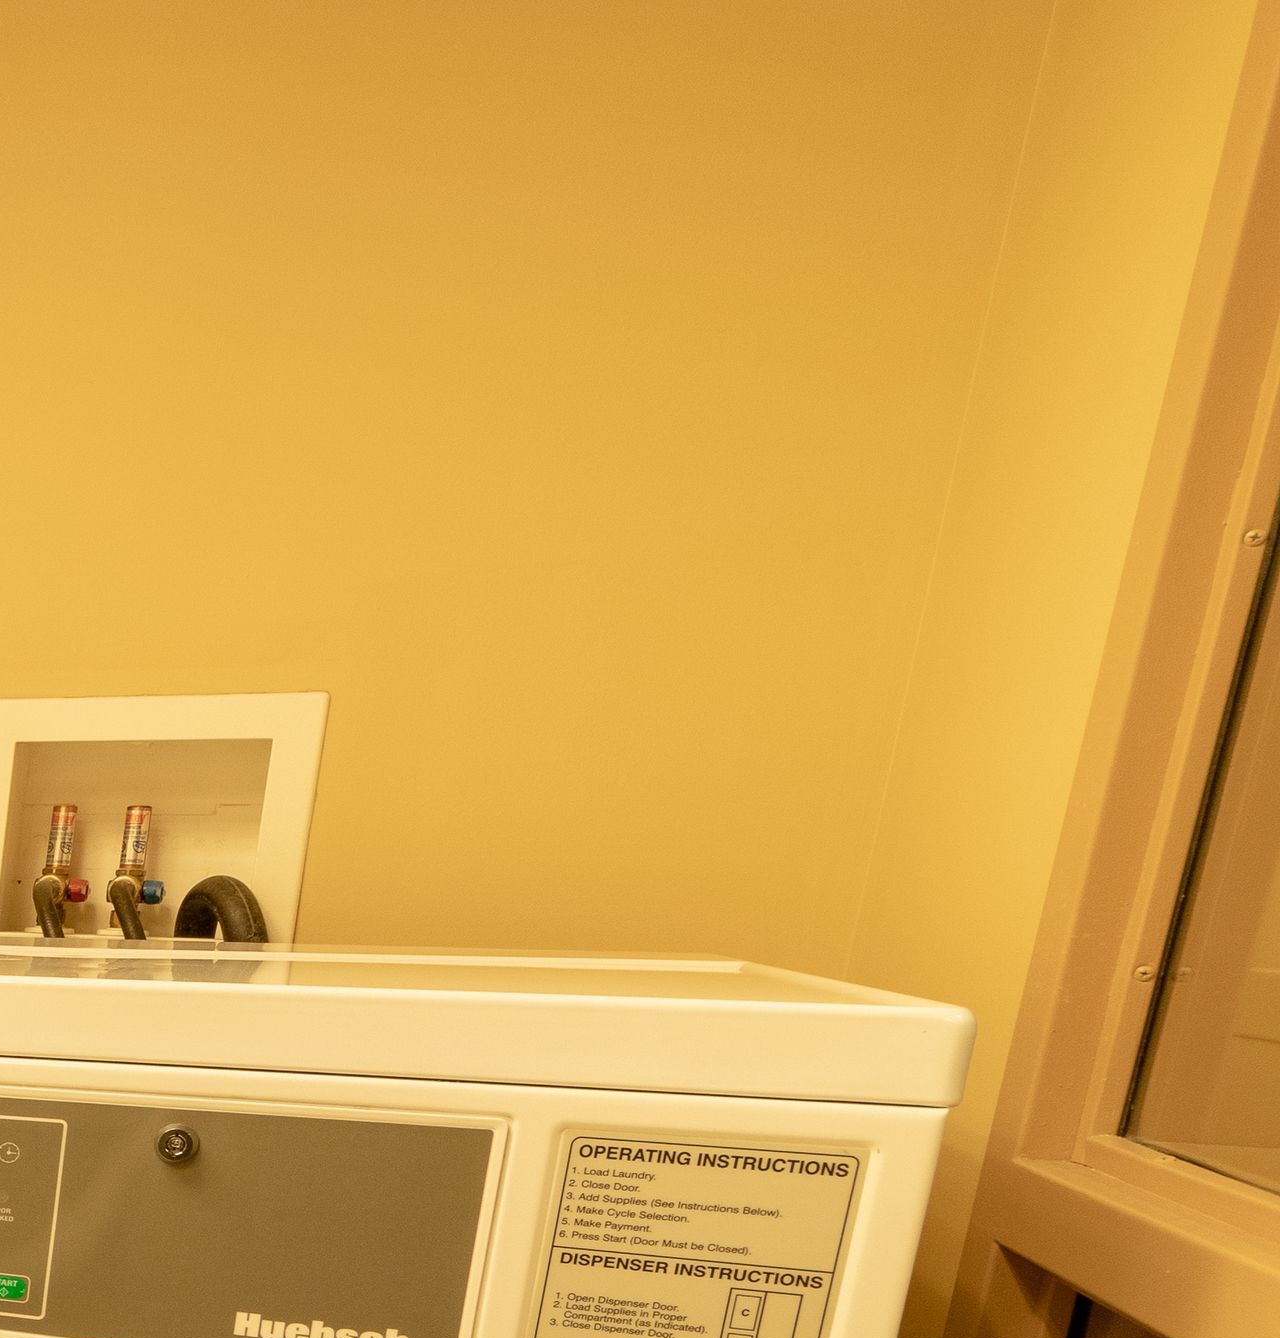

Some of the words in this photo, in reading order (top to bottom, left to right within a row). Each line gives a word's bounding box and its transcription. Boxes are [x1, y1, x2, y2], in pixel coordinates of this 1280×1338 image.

[579, 1144, 691, 1165] OPERATING
[696, 1153, 849, 1177] INSTRUCTIONS
[572, 1166, 580, 1174] 1.
[583, 1167, 609, 1176] Load
[611, 1169, 656, 1181] Laundry.
[568, 1178, 577, 1187] 2.
[581, 1179, 610, 1189] Close
[612, 1182, 640, 1192] Door.
[563, 1204, 572, 1212] 4.
[576, 1205, 604, 1215] Make
[606, 1208, 636, 1218] Cycle
[638, 1210, 689, 1222] Selection.
[565, 1191, 575, 1200] 3.
[578, 1192, 600, 1201] Add
[602, 1194, 647, 1206] Supplies
[650, 1199, 674, 1208] (See
[677, 1201, 739, 1214] Instructions
[742, 1206, 782, 1218] Below).
[560, 1217, 570, 1225] 5.
[573, 1218, 601, 1228] Make
[604, 1220, 651, 1232] Payment.
[558, 1229, 567, 1238] 6.
[571, 1230, 599, 1240] Press
[602, 1233, 626, 1243] Start
[629, 1236, 659, 1246] (Door
[662, 1239, 687, 1248] Must
[690, 1242, 704, 1250] be
[706, 1243, 751, 1256] Closed).
[560, 1252, 668, 1273] DISPENSER
[674, 1263, 823, 1288] INSTRUCTIONS
[552, 1300, 561, 1308] 2.
[565, 1301, 590, 1311] Load
[593, 1304, 636, 1316] Supplies
[639, 1309, 649, 1317] in
[652, 1310, 687, 1321] Proper
[555, 1291, 563, 1299] 1.
[567, 1292, 594, 1302] Open
[597, 1295, 649, 1308] Dispenser
[651, 1301, 679, 1312] Door.
[741, 1308, 749, 1316] C
[549, 1317, 558, 1326] 3.
[562, 1319, 590, 1329] Close
[593, 1322, 645, 1335] Dispenser
[647, 1328, 674, 1338] Door.
[563, 1310, 632, 1325] Compartment
[635, 1318, 651, 1327] (as
[654, 1320, 707, 1334] Indicated).
